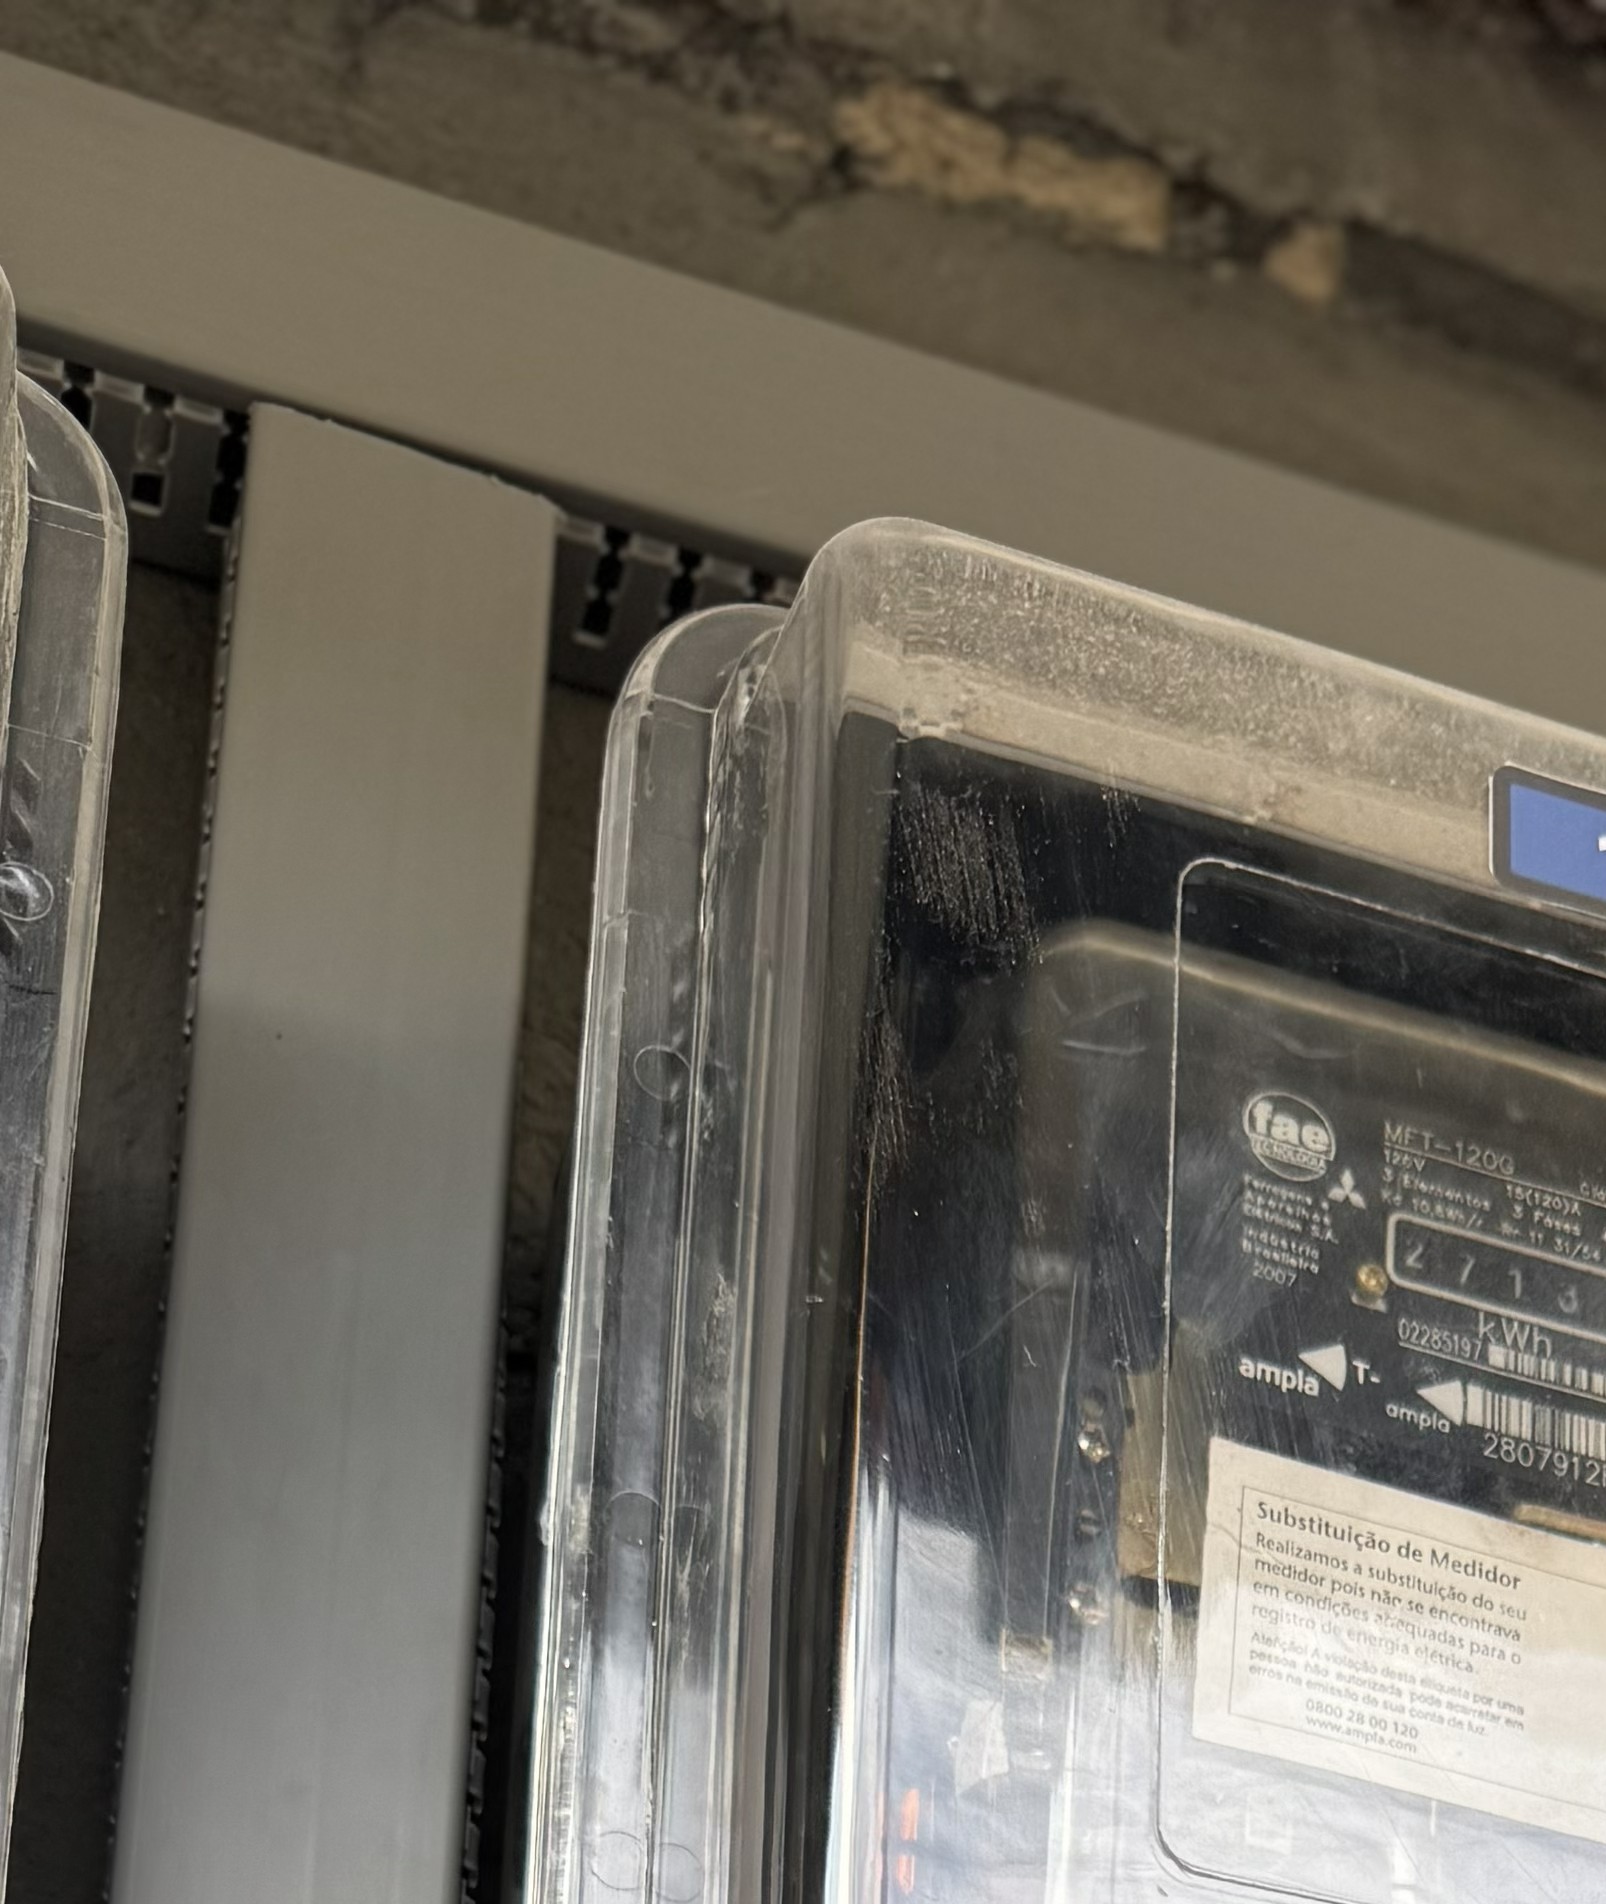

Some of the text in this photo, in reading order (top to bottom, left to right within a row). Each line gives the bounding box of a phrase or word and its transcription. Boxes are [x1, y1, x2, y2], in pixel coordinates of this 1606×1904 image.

[1253, 1100, 1330, 1153] fae
[1383, 1120, 1516, 1175] MFT-120G
[1382, 1167, 1393, 1182] 3
[1402, 1174, 1490, 1210] Elementos
[1511, 1204, 1523, 1218] 3
[1532, 1210, 1580, 1236] Fases
[1505, 1185, 1580, 1216] 15(120)A
[1252, 1260, 1296, 1286] 2007
[1397, 1318, 1482, 1360] 02285197
[1478, 1312, 1554, 1361] kWh
[1240, 1357, 1320, 1396] ampla
[1386, 1401, 1451, 1434] ampla
[1256, 1501, 1521, 1589] Substituição de Medidor
[1254, 1559, 1520, 1641] medidor pois não se encontrava
[1256, 1532, 1526, 1621] Realizamos a substituição do seu
[1251, 1603, 1478, 1674] registro de energia elétrica.
[1252, 1581, 1279, 1597] em
[1284, 1584, 1368, 1621] condições
[1469, 1641, 1505, 1660] para
[1510, 1653, 1521, 1664] o
[1248, 1664, 1282, 1679] erros
[1285, 1674, 1302, 1686] na
[1305, 1680, 1358, 1702] emissão
[1361, 1694, 1379, 1707] de
[1382, 1700, 1405, 1713] sua
[1408, 1707, 1445, 1725] conta
[1446, 1717, 1464, 1729] de
[1249, 1649, 1524, 1730] pessoa não autorizada pode acarretar em
[1324, 1654, 1378, 1674] violação
[1380, 1667, 1416, 1684] desta
[1419, 1677, 1470, 1700] etiqueta
[1472, 1694, 1493, 1706] por
[1497, 1701, 1524, 1715] uma
[1305, 1698, 1418, 1739] 0800 28 00 120
[1305, 1716, 1417, 1753] www.ampla.com
